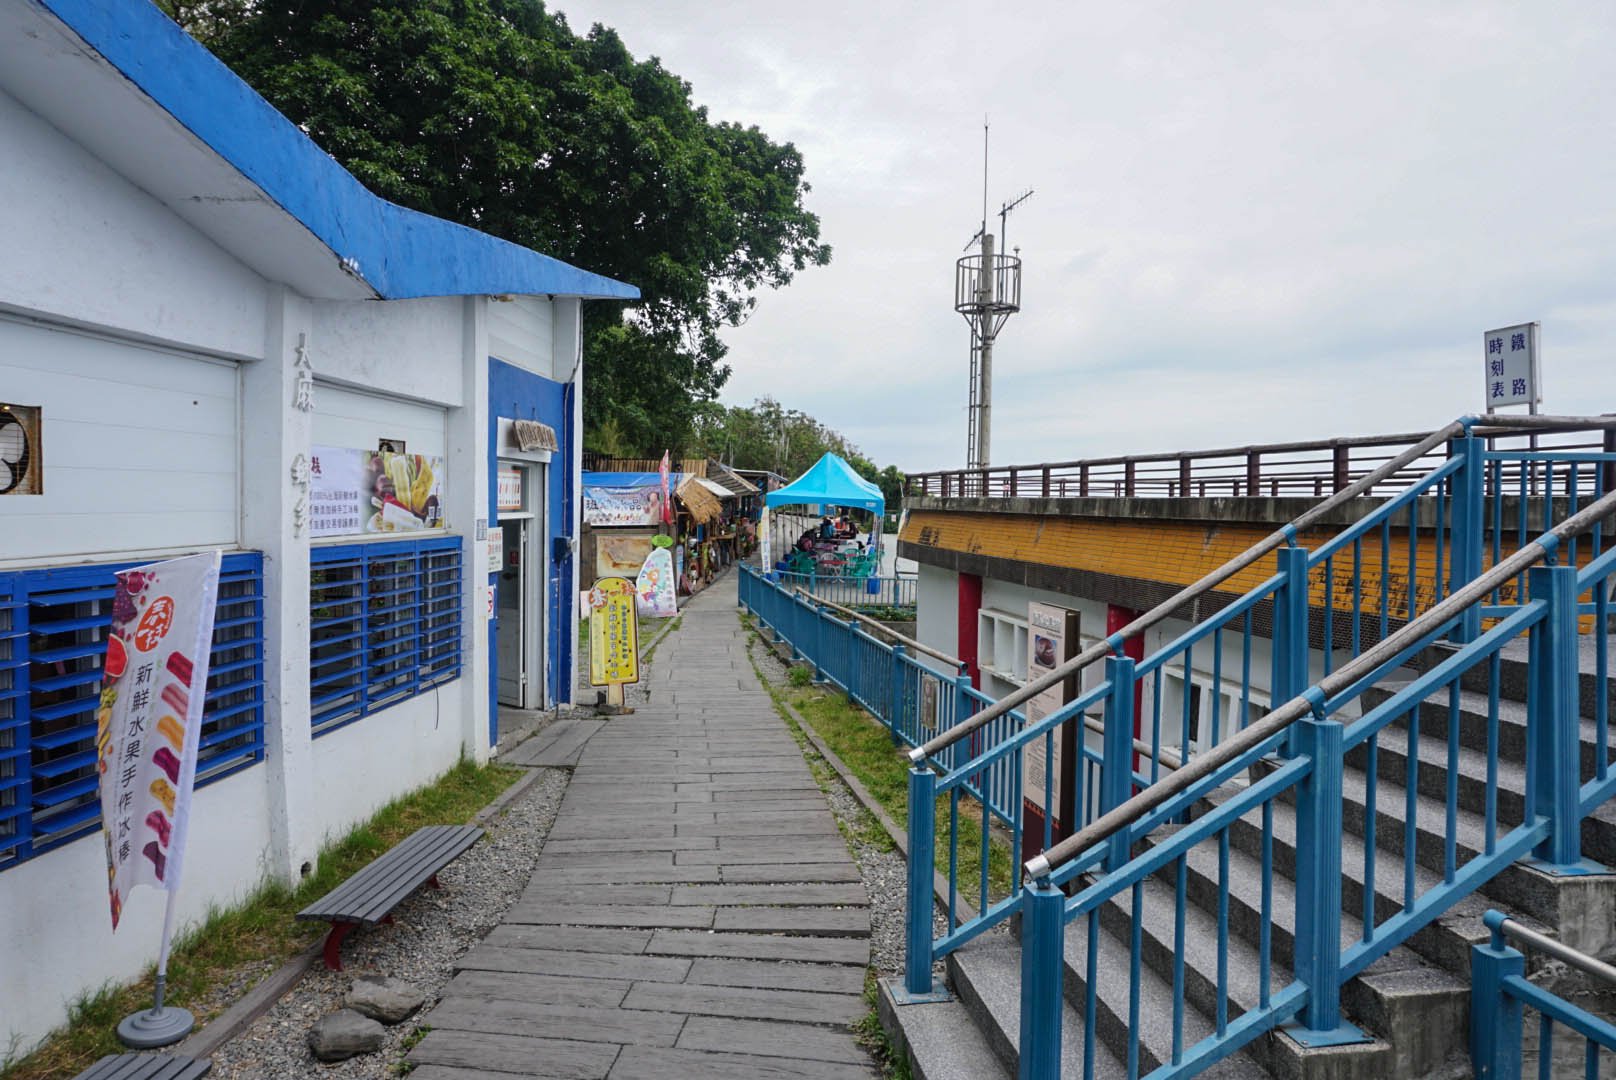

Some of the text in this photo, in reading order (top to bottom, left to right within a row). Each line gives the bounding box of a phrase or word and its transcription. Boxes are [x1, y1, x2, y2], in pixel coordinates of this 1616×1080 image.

[1489, 337, 1504, 399] 時刻表
[1511, 332, 1527, 396] 鐵路
[118, 661, 154, 865] 新鮮水果手作冰棒
